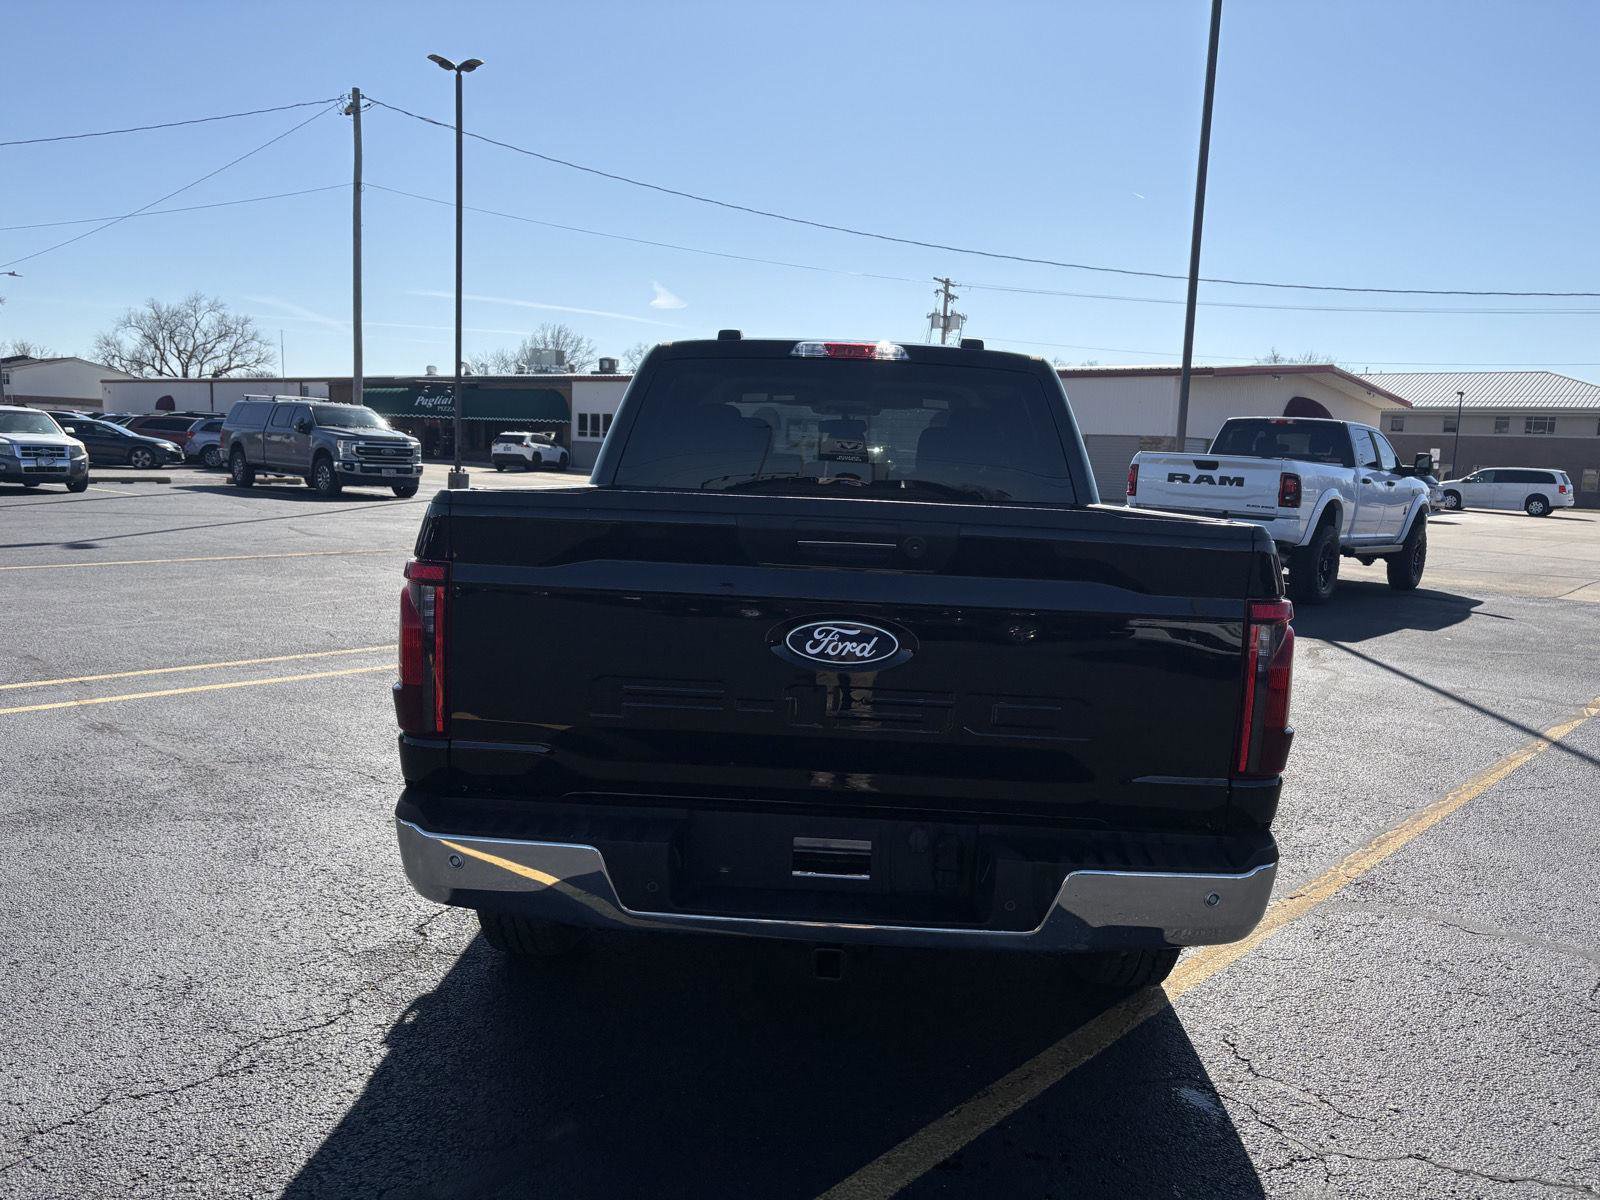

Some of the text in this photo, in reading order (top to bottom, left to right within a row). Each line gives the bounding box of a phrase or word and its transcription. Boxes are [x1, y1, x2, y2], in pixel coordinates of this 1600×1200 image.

[1167, 472, 1245, 487] RAM
[805, 626, 879, 657] Ford
[589, 674, 1094, 741] F-150
